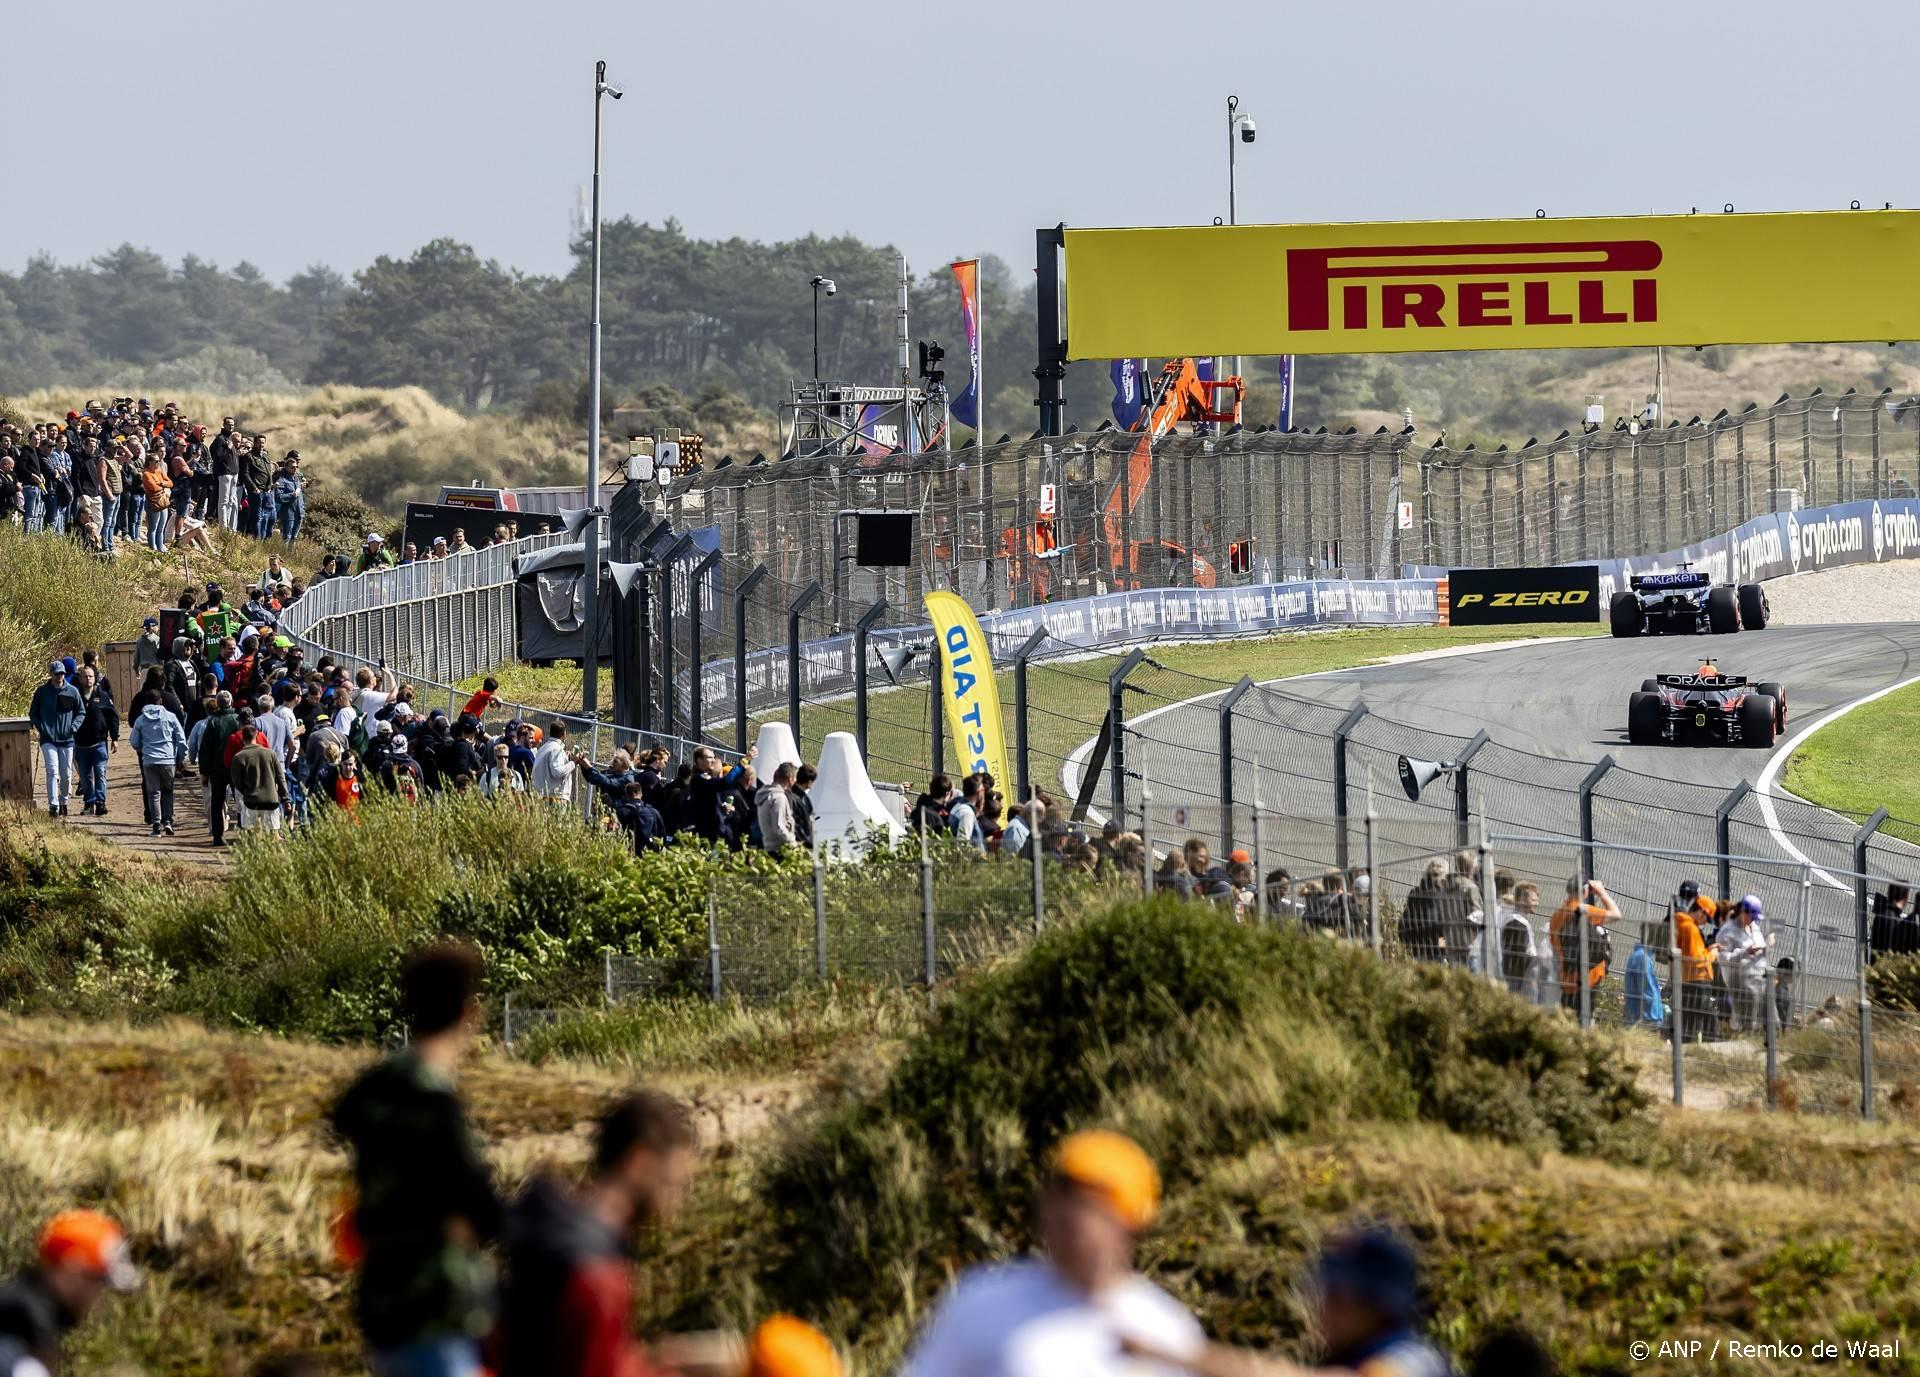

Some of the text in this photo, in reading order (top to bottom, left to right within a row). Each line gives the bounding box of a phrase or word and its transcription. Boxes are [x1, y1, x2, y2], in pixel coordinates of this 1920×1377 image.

[1286, 240, 1663, 331] PIRELLI
[1741, 528, 1783, 581] crypto.com
[1802, 514, 1863, 565] crypto.com
[1401, 584, 1435, 616] crypto.com
[1457, 594, 1484, 608] P
[1489, 590, 1590, 607] ZERO
[1666, 675, 1737, 686] ORACLE
